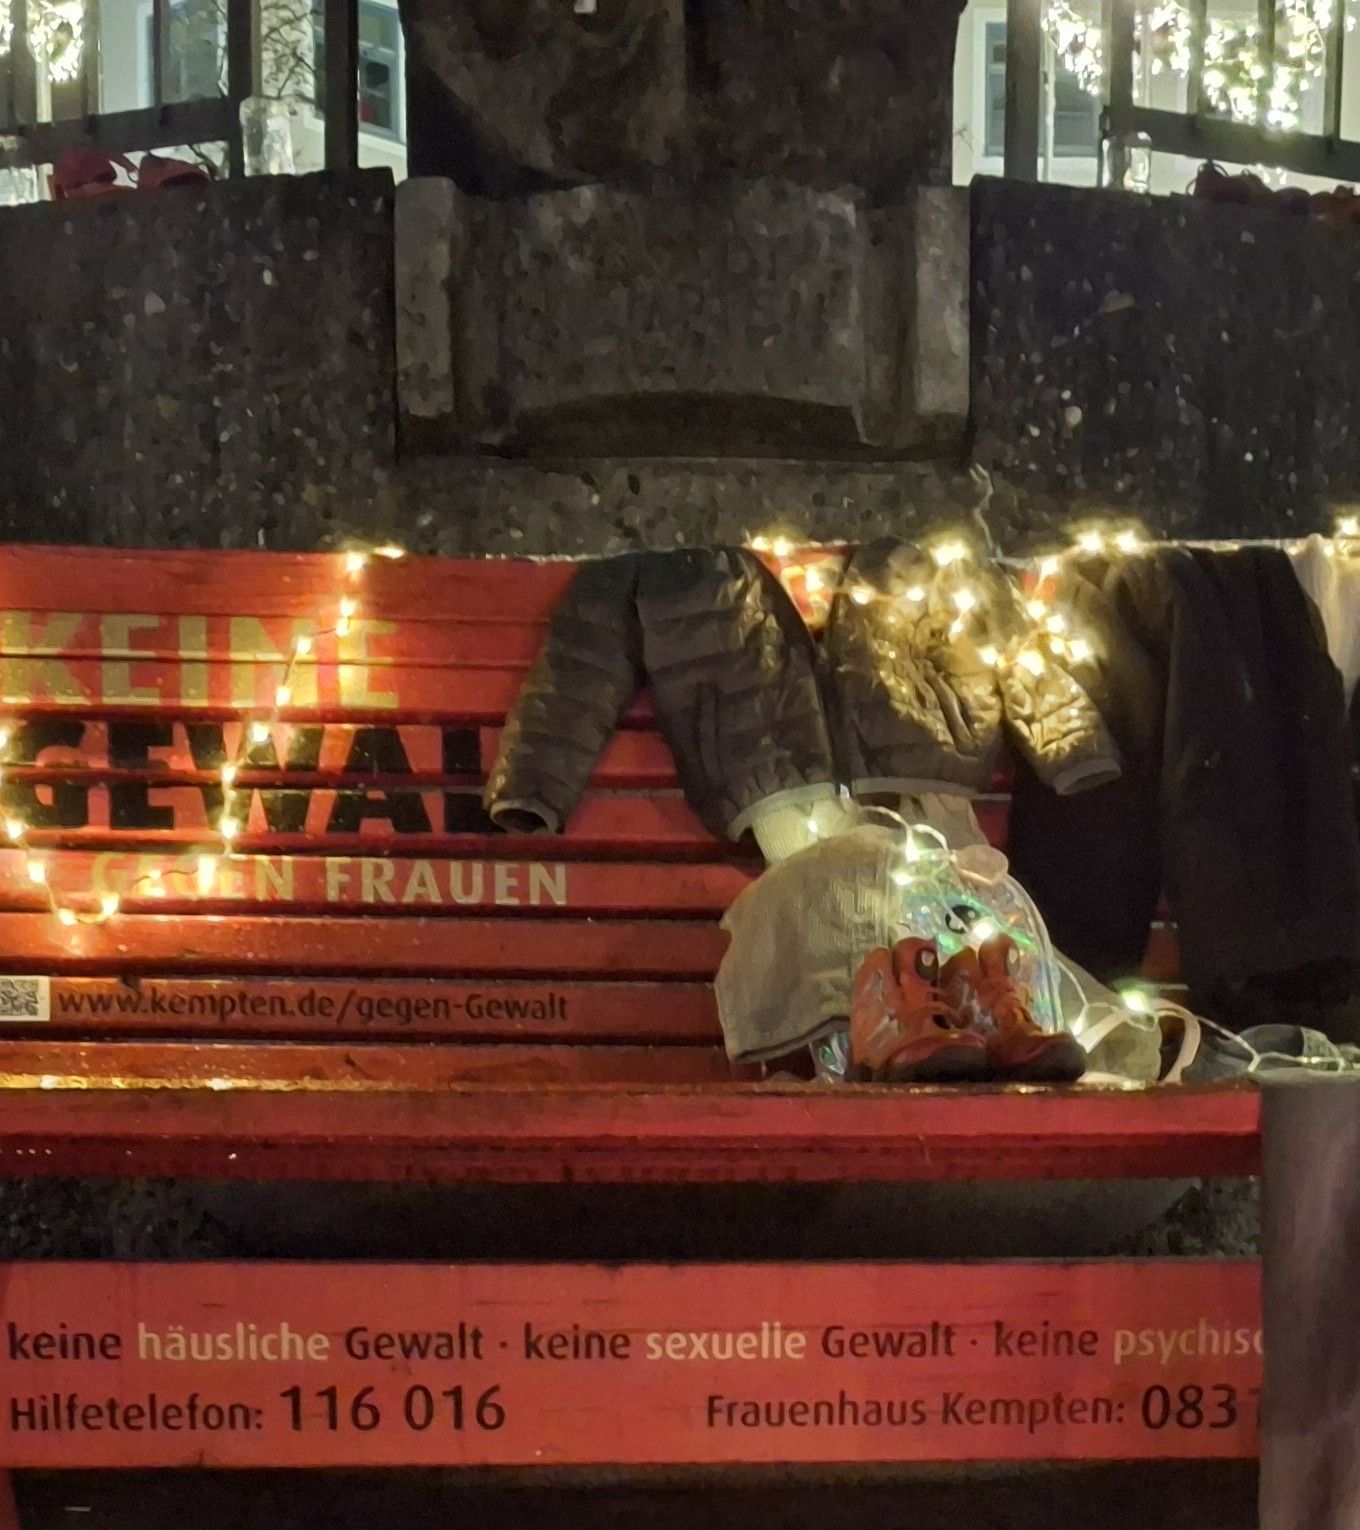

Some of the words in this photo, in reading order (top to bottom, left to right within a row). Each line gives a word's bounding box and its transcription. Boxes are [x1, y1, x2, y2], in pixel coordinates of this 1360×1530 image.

[1, 611, 400, 709] KEINE
[0, 718, 506, 834] GEWAL
[326, 856, 568, 906] FRAUEN
[59, 984, 568, 1024] www.kempten.de/gegen-Gewalt
[7, 1322, 122, 1361] keine
[139, 1322, 330, 1362] häusliche
[345, 1321, 483, 1361] Gewalt
[523, 1322, 631, 1361] keine
[645, 1321, 807, 1361] sexuelle
[821, 1322, 956, 1358] Gewalt
[993, 1321, 1098, 1356] keine
[1114, 1318, 1263, 1366] psychisc
[10, 1394, 263, 1432] Hilfetelefon:
[280, 1386, 381, 1433] 116
[403, 1386, 506, 1433] 016
[707, 1390, 926, 1429] Frauenhaus
[941, 1390, 1124, 1434] Kempten:
